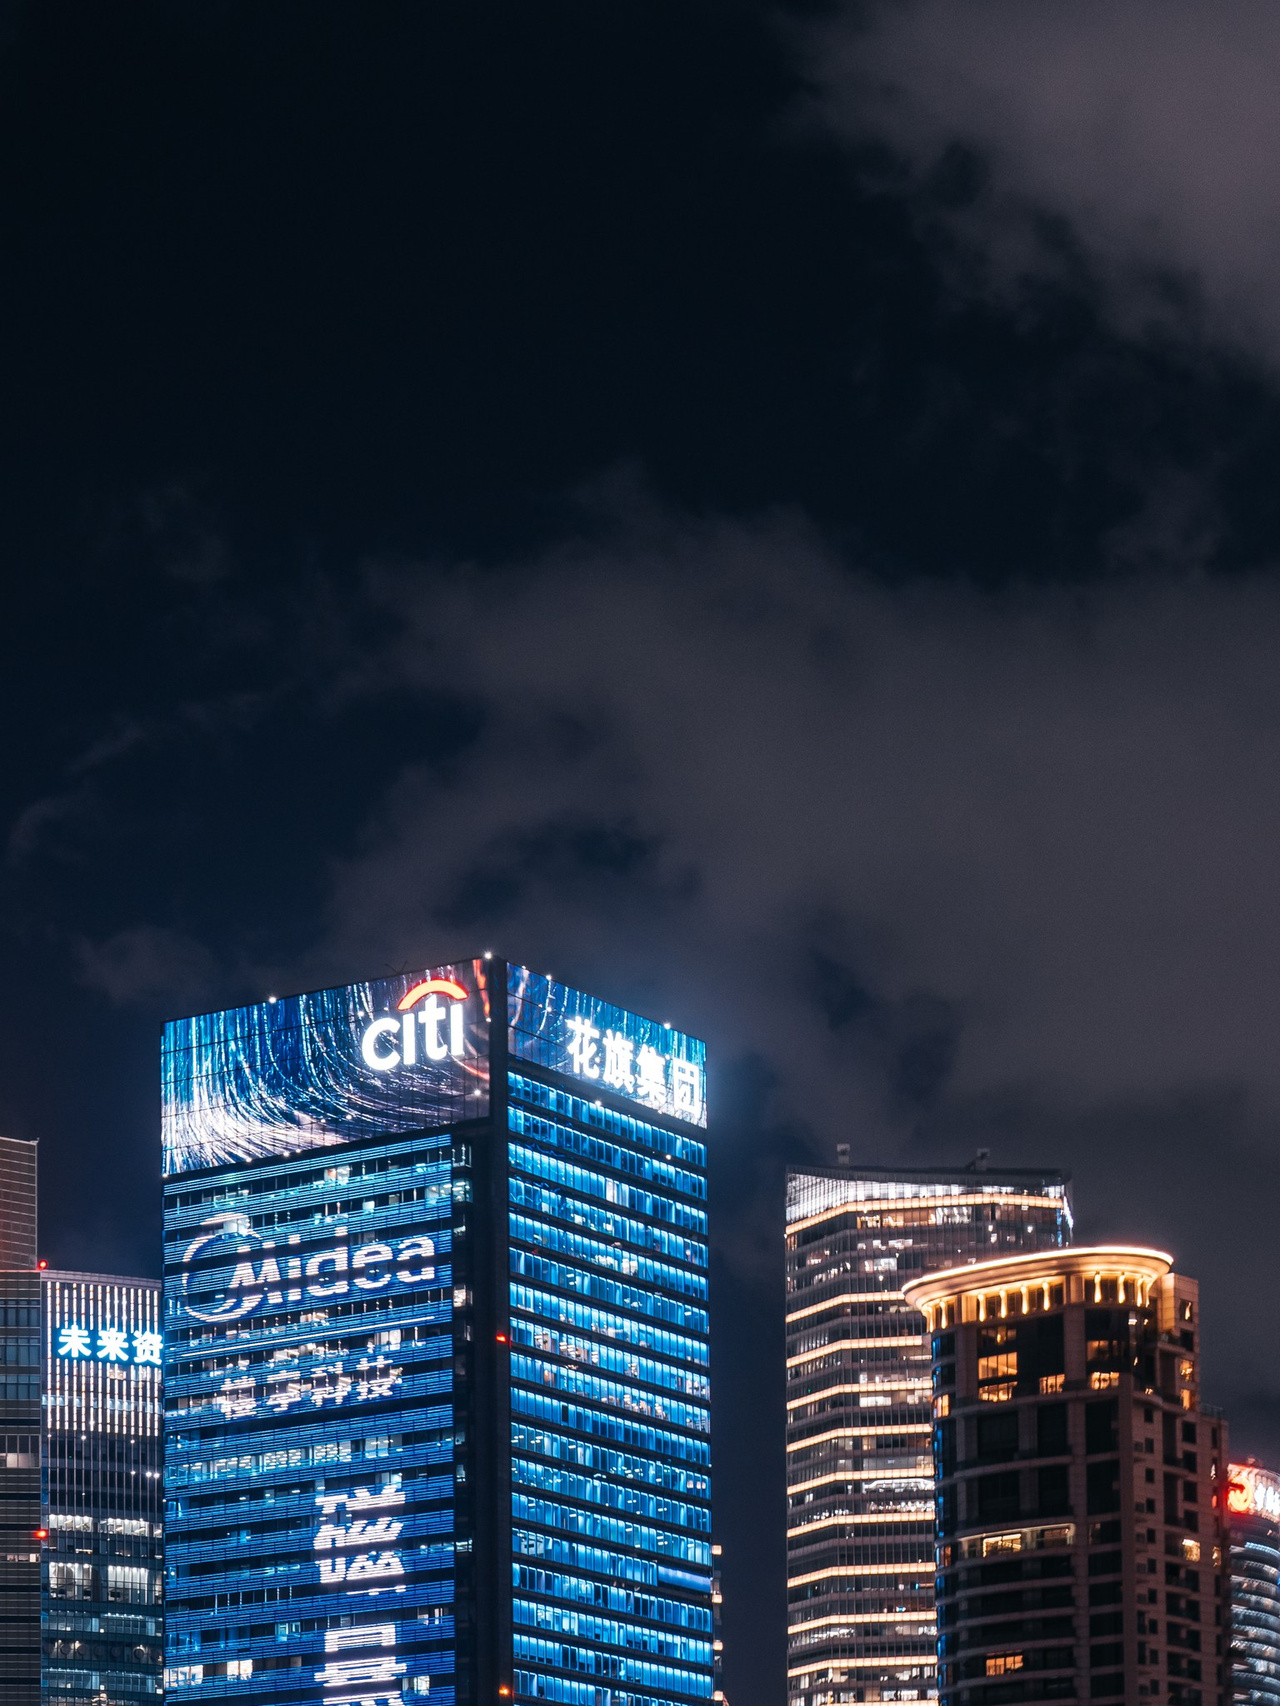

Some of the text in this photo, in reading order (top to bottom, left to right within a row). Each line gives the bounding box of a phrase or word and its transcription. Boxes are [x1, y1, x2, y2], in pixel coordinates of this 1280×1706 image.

[361, 990, 466, 1071] citi
[564, 1015, 701, 1117] 花旗集团
[217, 1222, 437, 1312] Midea
[58, 1324, 163, 1365] 未来资
